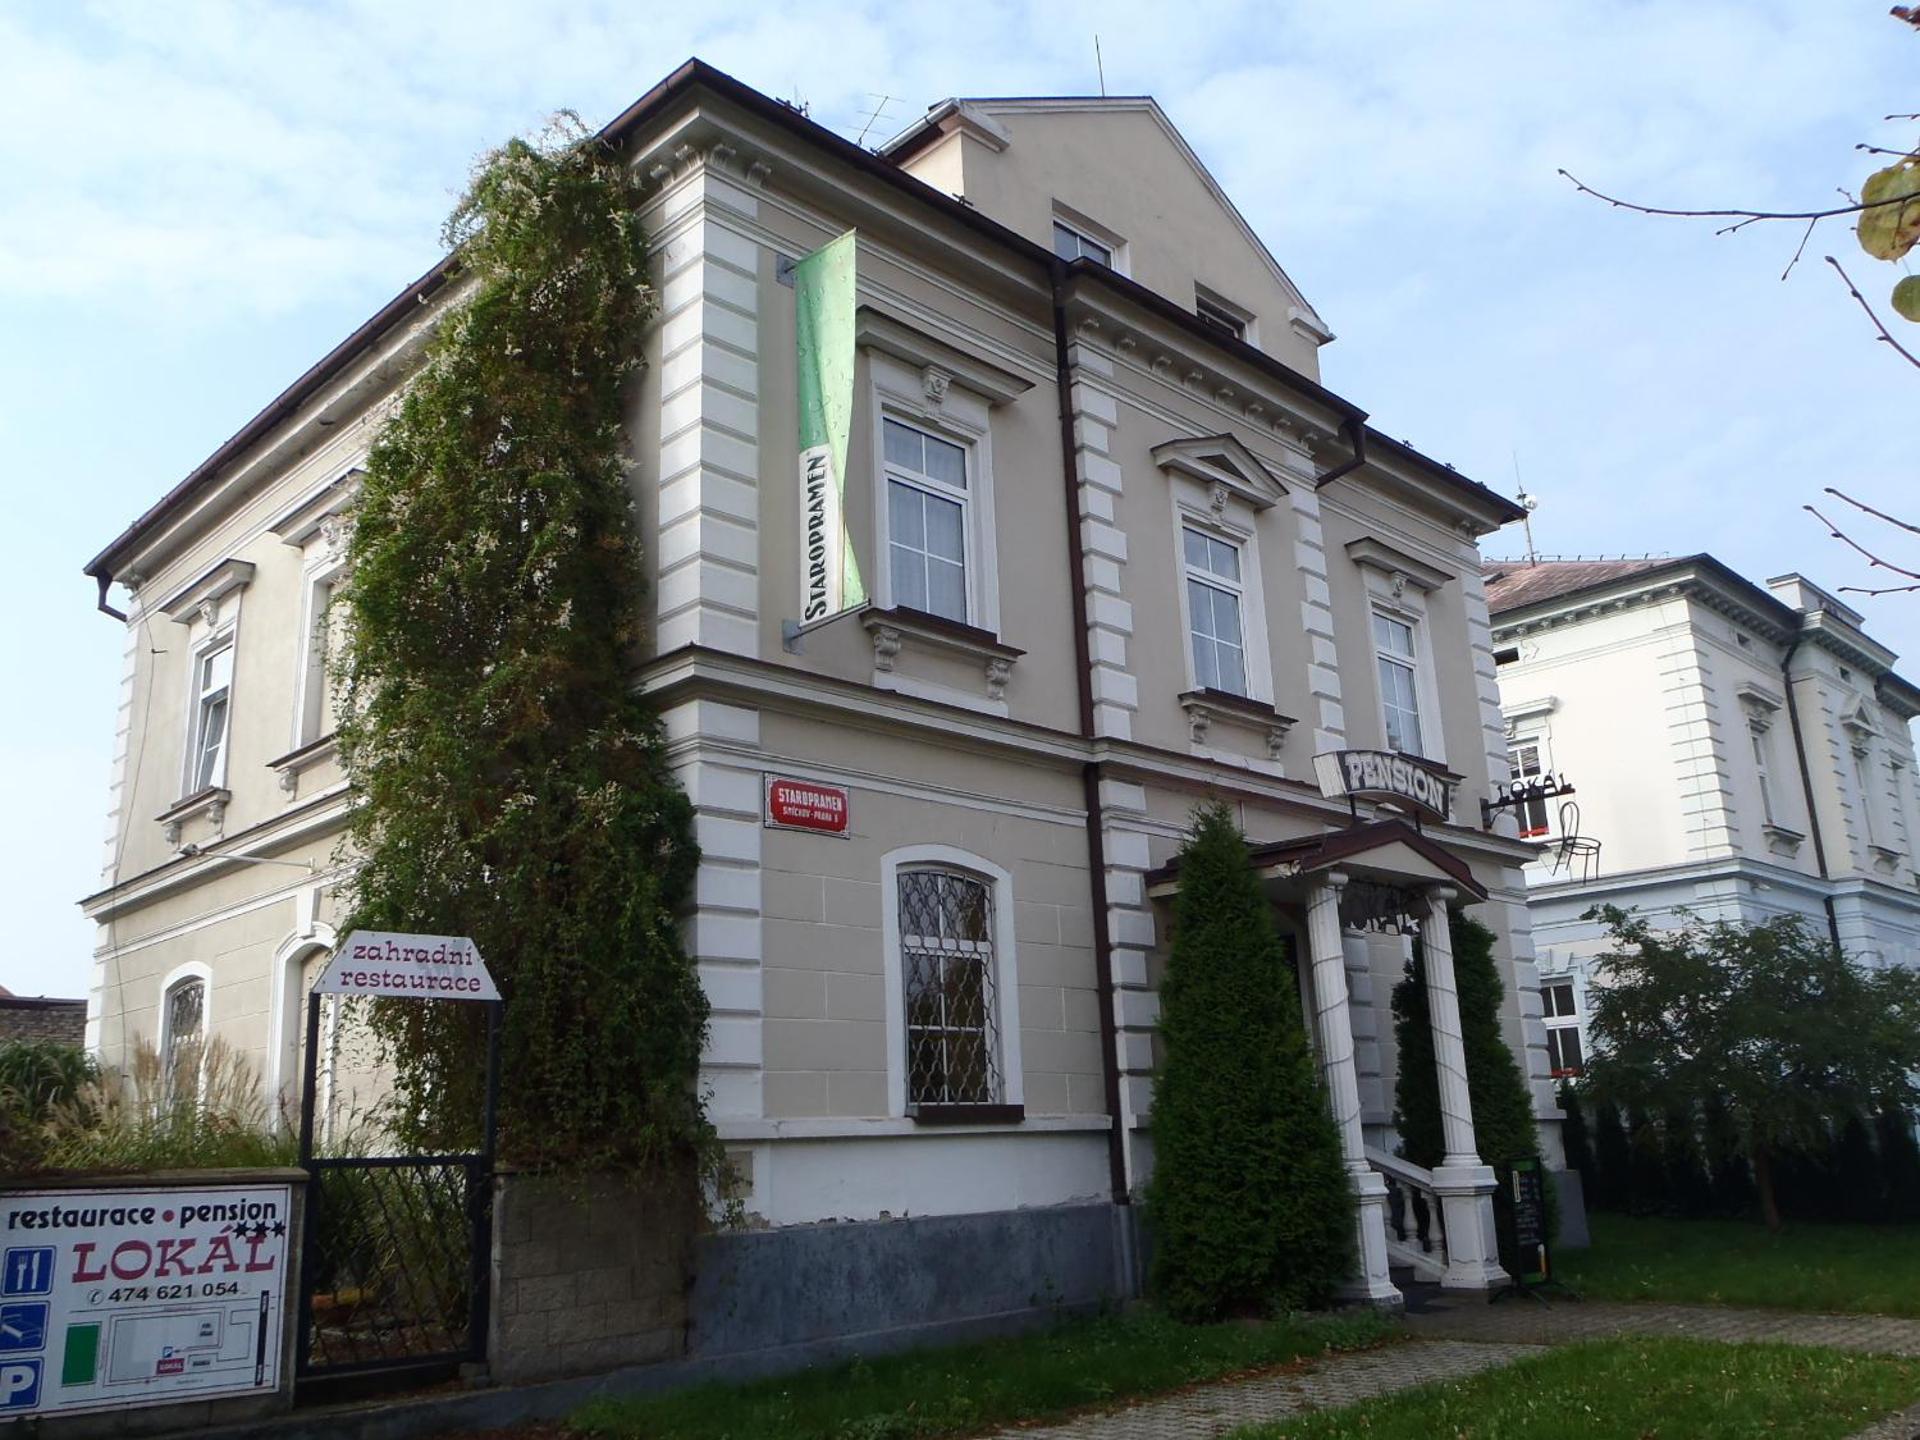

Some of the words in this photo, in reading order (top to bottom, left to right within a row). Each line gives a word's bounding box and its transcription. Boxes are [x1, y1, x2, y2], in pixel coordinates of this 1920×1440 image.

[804, 455, 828, 621] STAROPRAMEN
[1344, 752, 1445, 814] PENSION
[1497, 769, 1573, 801] LOKÁL
[778, 787, 842, 812] STAROPRAMEN
[353, 940, 473, 966] zahradní
[341, 969, 481, 992] restaurace
[8, 1205, 155, 1230] restaurace
[180, 1198, 276, 1228] pension
[72, 1225, 276, 1283] LOKÁL
[108, 1286, 149, 1303] 474
[156, 1284, 194, 1300] 621
[202, 1281, 239, 1297] 054
